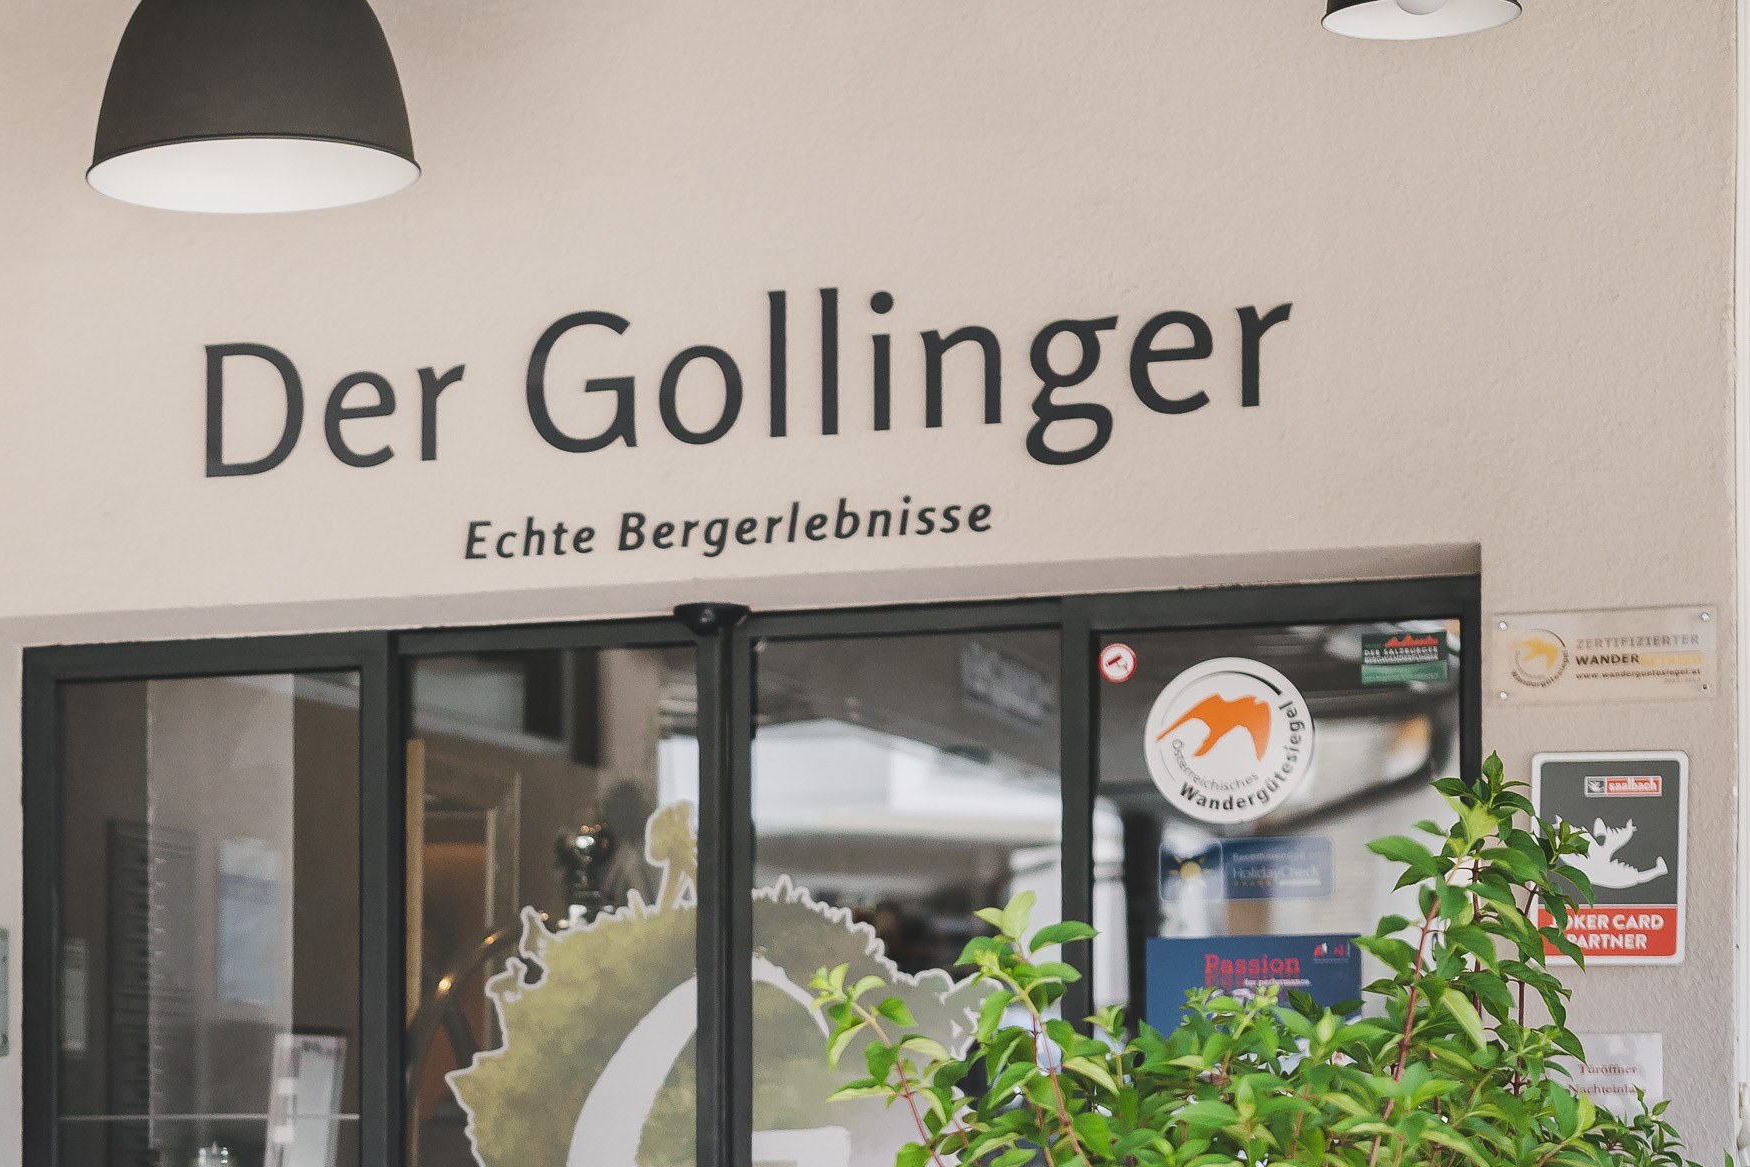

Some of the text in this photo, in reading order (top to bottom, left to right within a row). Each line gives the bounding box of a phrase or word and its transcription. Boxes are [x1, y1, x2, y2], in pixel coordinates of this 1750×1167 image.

[205, 288, 1293, 477] Der Gollinger
[465, 495, 992, 560] Echte Bergerlebnisse
[1576, 634, 1700, 649] ZERTIFIZIERTER
[1180, 700, 1305, 811] Wandergütesiegel
[1608, 777, 1658, 792] saalbach
[1612, 914, 1665, 930] CARD
[1205, 954, 1300, 974] Passion
[1578, 1063, 1638, 1075] Türöffner
[1567, 1083, 1647, 1095] Nachteinlas
